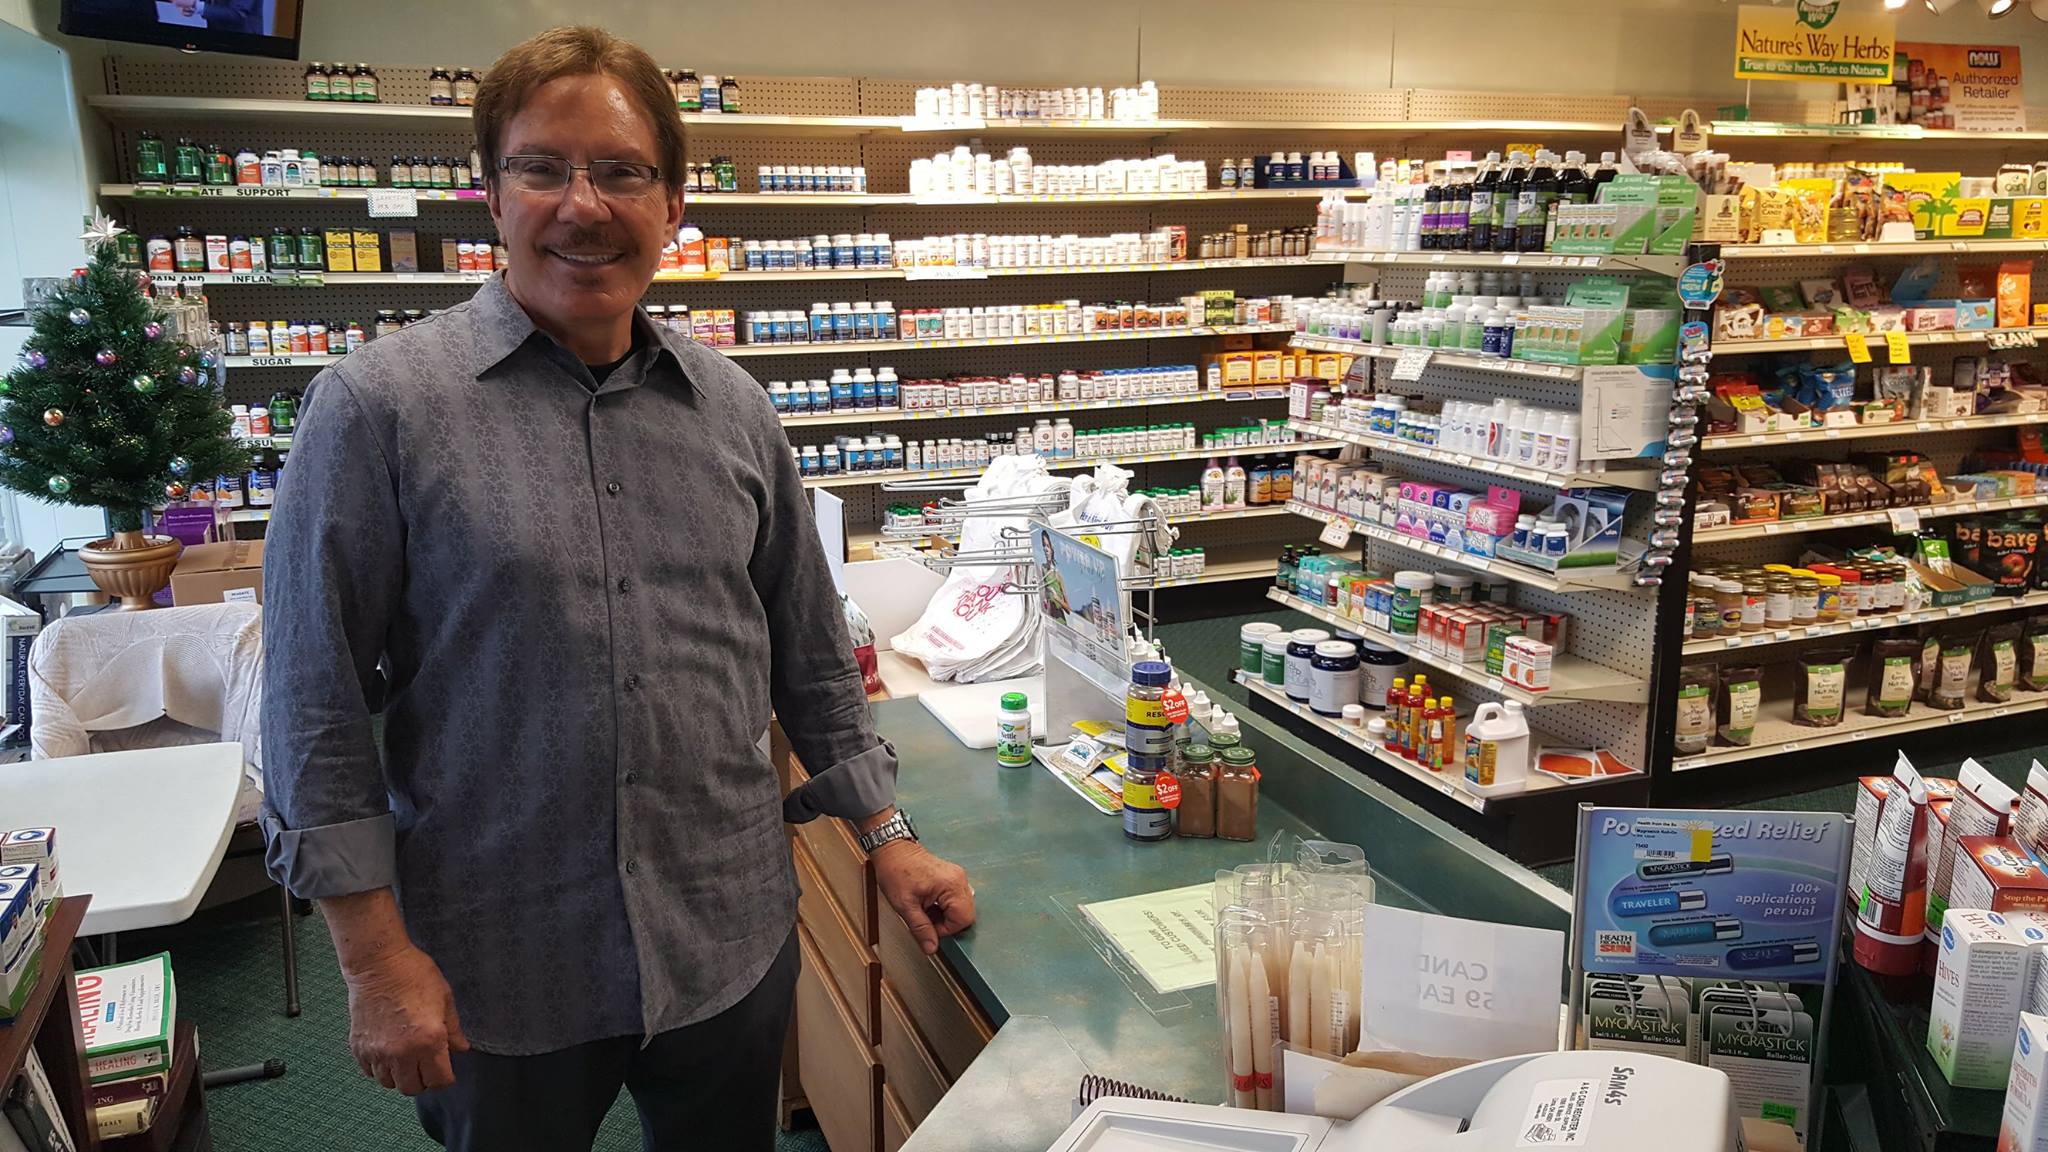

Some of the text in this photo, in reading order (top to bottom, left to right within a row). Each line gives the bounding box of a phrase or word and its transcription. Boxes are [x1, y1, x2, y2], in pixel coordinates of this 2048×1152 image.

[1740, 30, 1890, 60] Nature's Way Herbs
[1743, 59, 1885, 77] True to the herb. True to Nature.
[1953, 72, 2018, 87] Authorized
[1963, 86, 2010, 99] Retailer
[236, 188, 291, 197] SUPPORT
[150, 275, 176, 284] PAIN
[180, 275, 205, 284] AND
[1993, 332, 2038, 348] RAW
[252, 358, 292, 367] SUGAR
[236, 438, 273, 448] ESSU
[1987, 529, 2038, 548] bare
[951, 600, 979, 622] YOU
[18, 638, 27, 668] NATURAL
[17, 670, 26, 705] EVERYDAY
[1162, 699, 1185, 711] $2 OFF
[1156, 784, 1180, 795] $2 OFF
[1756, 820, 1829, 843] Relief
[1789, 882, 1821, 894] 100+
[1621, 897, 1672, 909] TRAVELER
[1735, 894, 1817, 906] applications
[2003, 894, 2022, 903] Stop
[1763, 906, 1815, 918] per vial
[1962, 911, 2007, 943] HIVES
[1148, 928, 1174, 950] TO OUR
[1600, 934, 1632, 942] HEALTH
[1600, 944, 1632, 953] SUN
[1938, 959, 1960, 988] HIVES
[1642, 1034, 1681, 1044] Roller-Stick
[1766, 1051, 1806, 1061] Roller-Stick
[95, 1055, 137, 1072] HEALING
[1604, 1066, 1635, 1106] SAM4S
[1575, 1094, 1587, 1107] CASH
[1567, 1107, 1583, 1132] REGISTER,
